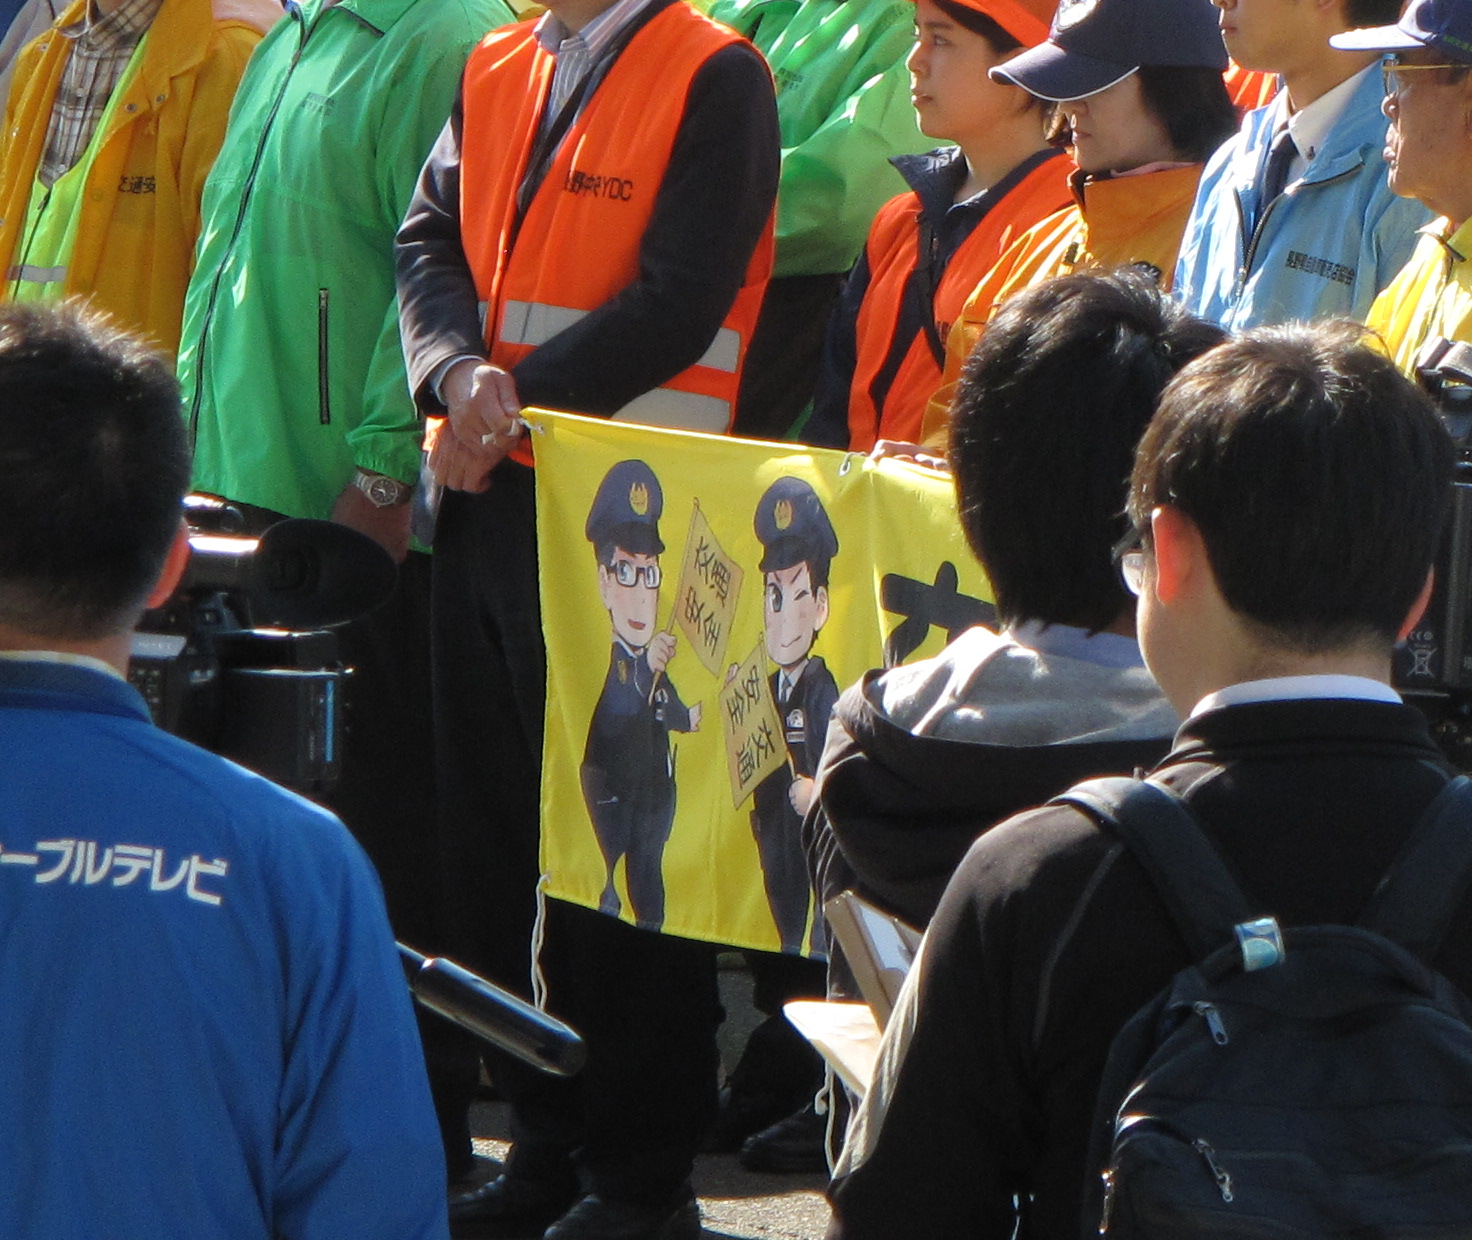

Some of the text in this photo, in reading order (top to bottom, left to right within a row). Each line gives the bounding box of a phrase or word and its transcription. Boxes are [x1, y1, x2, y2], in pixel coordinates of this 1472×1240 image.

[0, 839, 229, 906] ーブルテレビ
